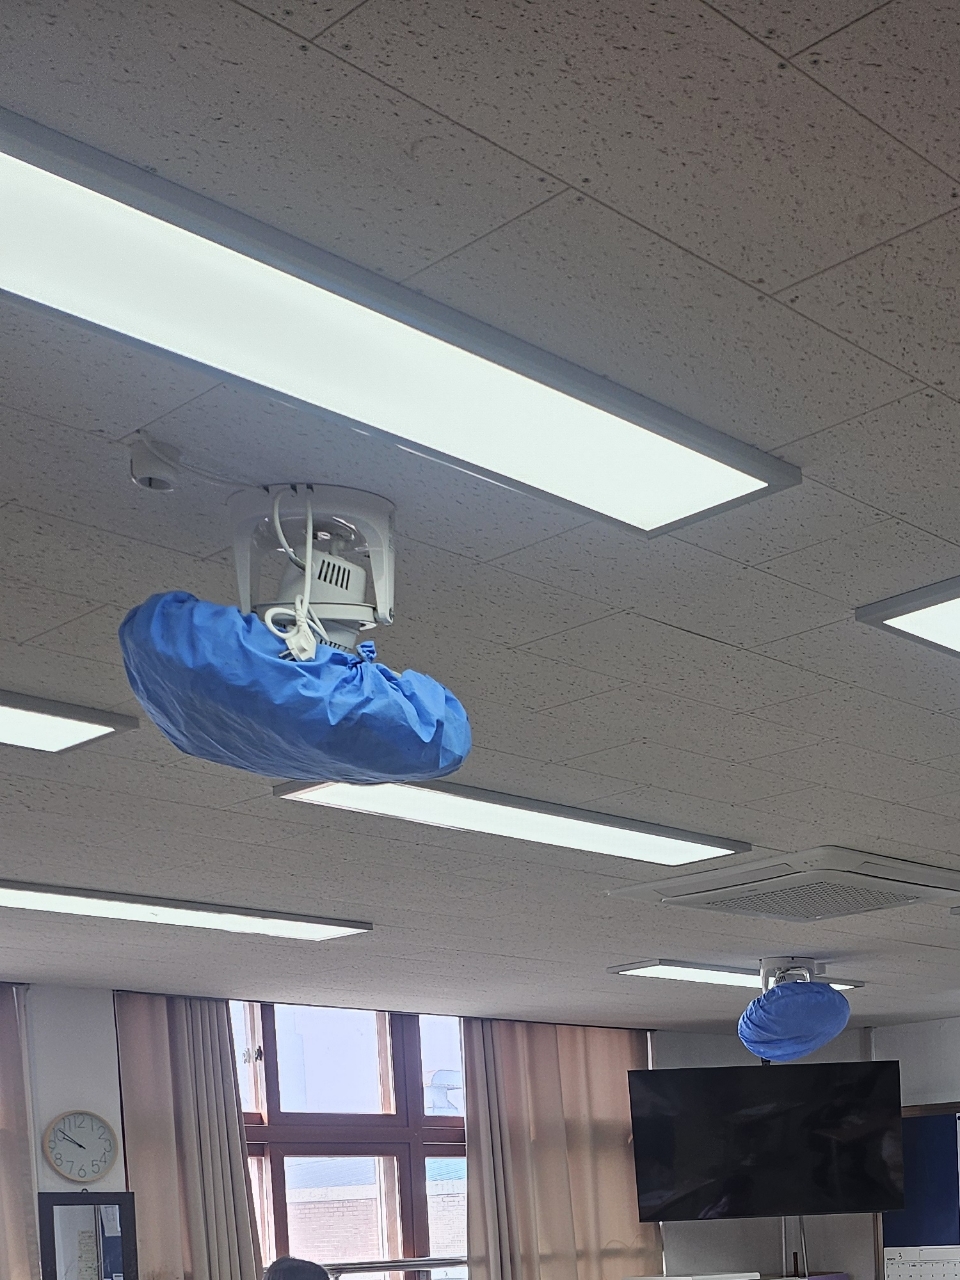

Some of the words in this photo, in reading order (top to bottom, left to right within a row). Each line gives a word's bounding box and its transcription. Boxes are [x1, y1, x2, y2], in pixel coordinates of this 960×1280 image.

[62, 1117, 72, 1131] 11
[73, 1114, 86, 1130] 12
[52, 1127, 65, 1142] 10
[98, 1125, 107, 1140] 2
[48, 1139, 56, 1153] 9
[103, 1138, 113, 1153] 3
[54, 1152, 64, 1166] 8
[99, 1151, 108, 1165] 4
[66, 1160, 75, 1174] 7
[77, 1164, 87, 1178] 6
[91, 1159, 100, 1174] 5
